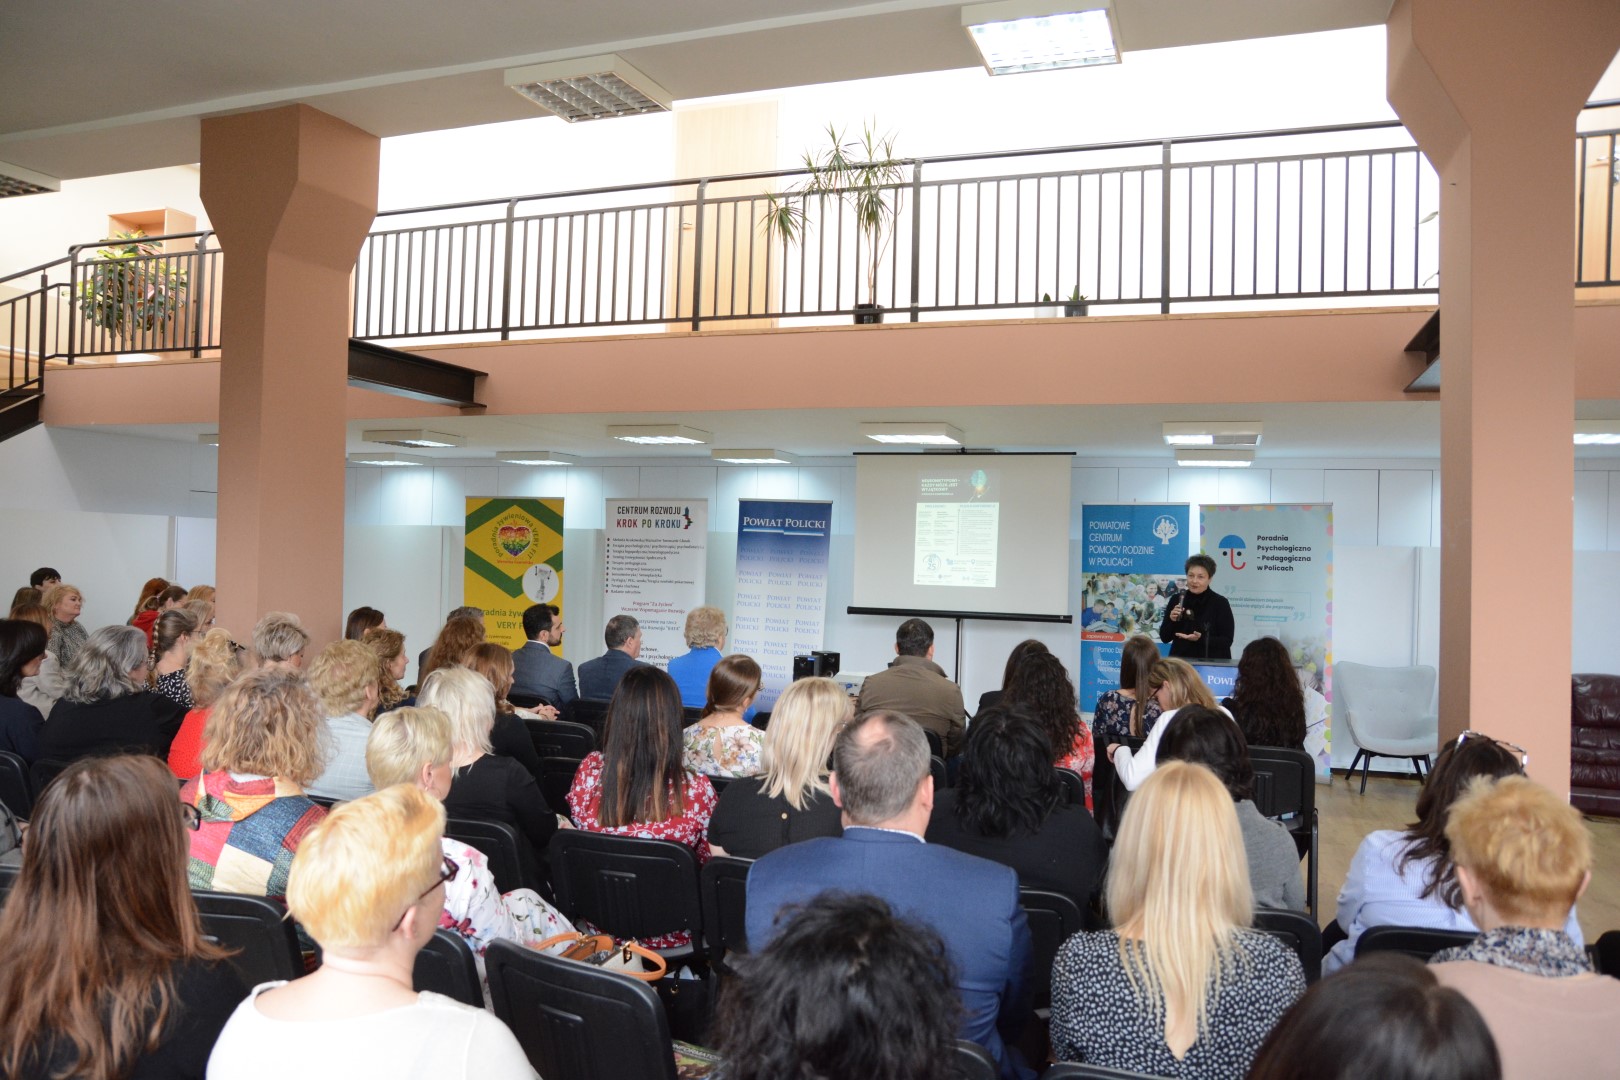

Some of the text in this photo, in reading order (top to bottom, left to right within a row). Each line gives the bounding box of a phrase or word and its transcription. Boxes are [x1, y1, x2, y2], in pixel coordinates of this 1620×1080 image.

[618, 506, 681, 514] CENTRUM ROZWOJU
[616, 519, 680, 528] KROK PO KROKU
[743, 516, 826, 528] POWIAT POLICKI
[1089, 521, 1130, 530] POWIATOWE
[1089, 533, 1122, 542] CENTRUM
[1089, 546, 1154, 554] POMOCY RODZINIE
[1097, 558, 1132, 566] POLICACH
[1262, 555, 1312, 563] Pedagogiczna
[484, 608, 506, 616] radnia
